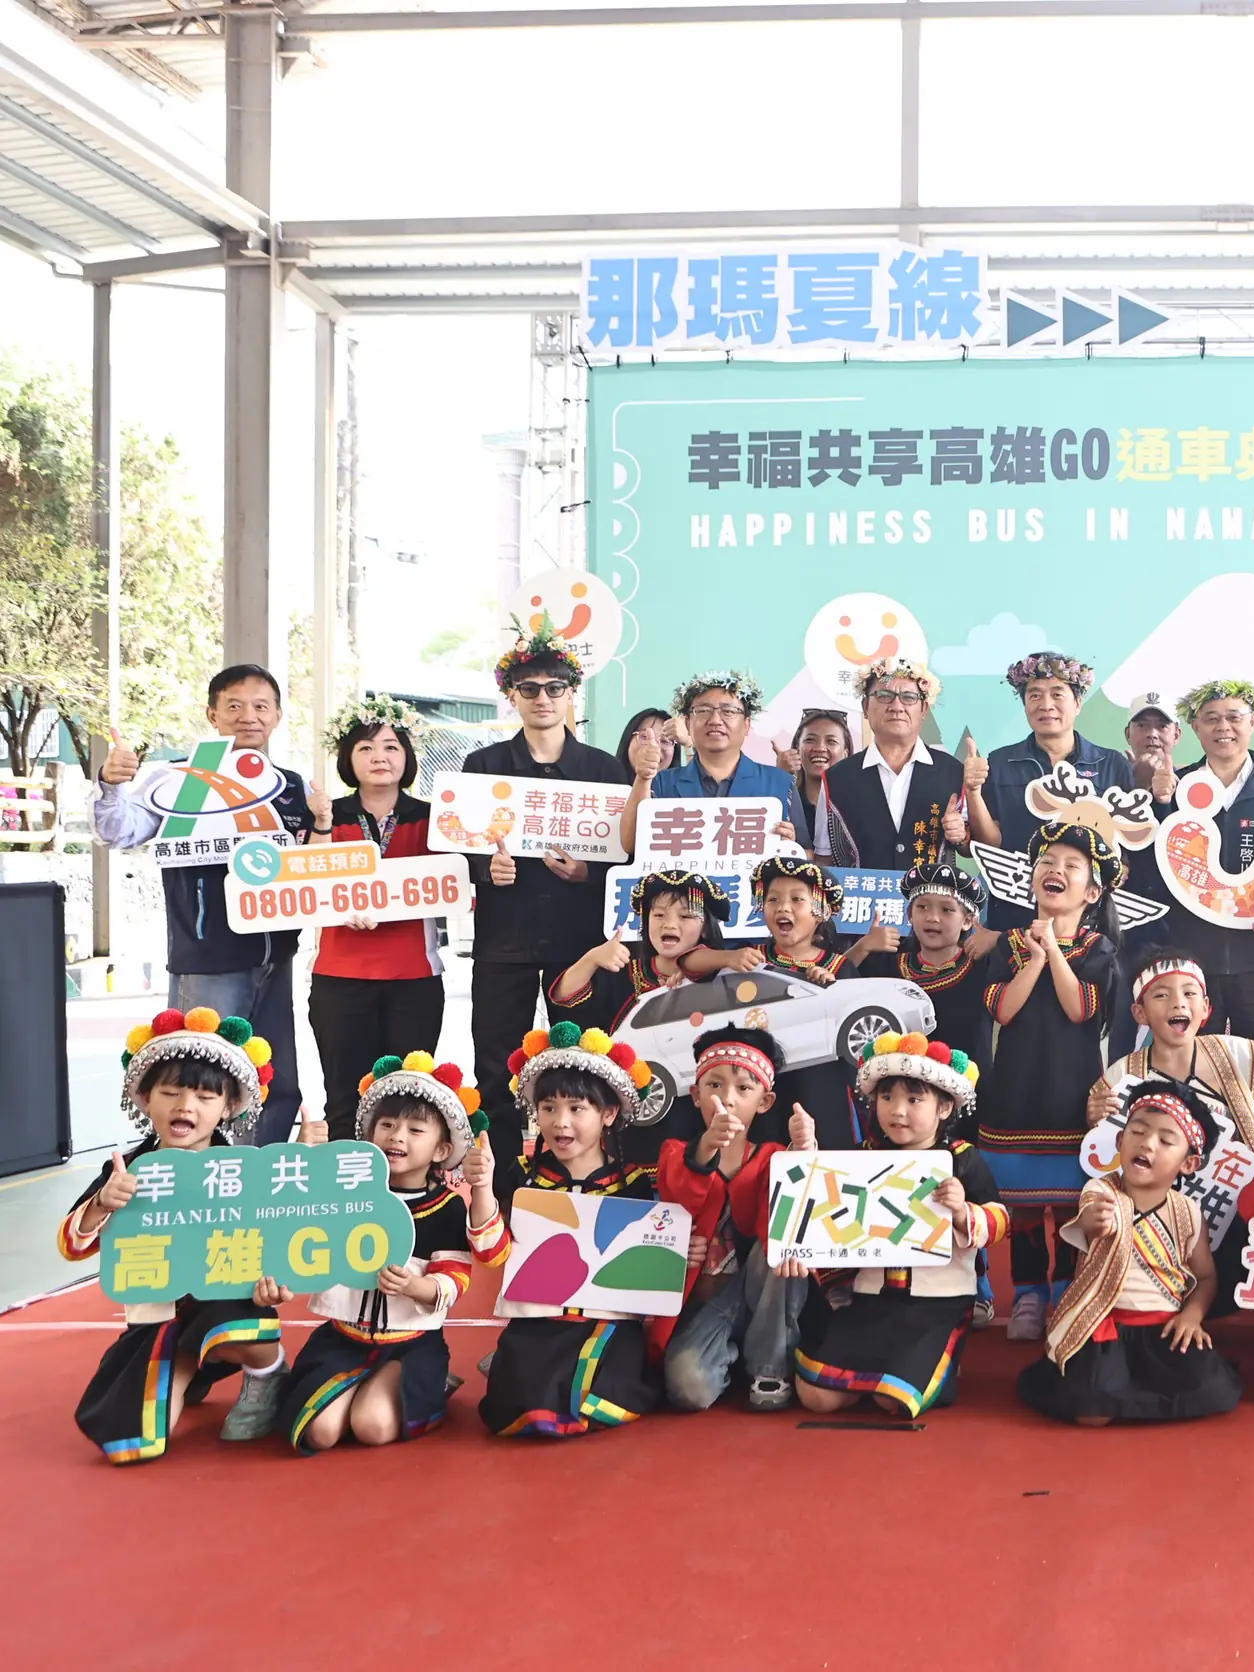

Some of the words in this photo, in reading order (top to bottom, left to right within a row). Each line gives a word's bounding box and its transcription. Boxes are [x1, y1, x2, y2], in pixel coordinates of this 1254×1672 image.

[587, 250, 982, 348] 那瑪夏線
[690, 508, 932, 549] HAPPINESS
[967, 507, 1045, 542] BUS
[1085, 507, 1129, 541] IN
[524, 789, 627, 817] 幸福共享
[522, 814, 611, 839] 高雄GO
[650, 806, 767, 857] 幸福
[155, 833, 288, 858] 高雄市區所
[287, 849, 369, 875] 電話預約
[642, 859, 766, 872] HAPPINES
[1178, 863, 1209, 887] 高雄
[239, 874, 459, 920] 0800-660-696
[841, 896, 912, 926] 那瑪
[136, 1151, 374, 1202] 幸福共享
[141, 1207, 243, 1228] SHANLIN
[255, 1203, 339, 1219] HAPPINESS
[345, 1201, 374, 1213] BUS
